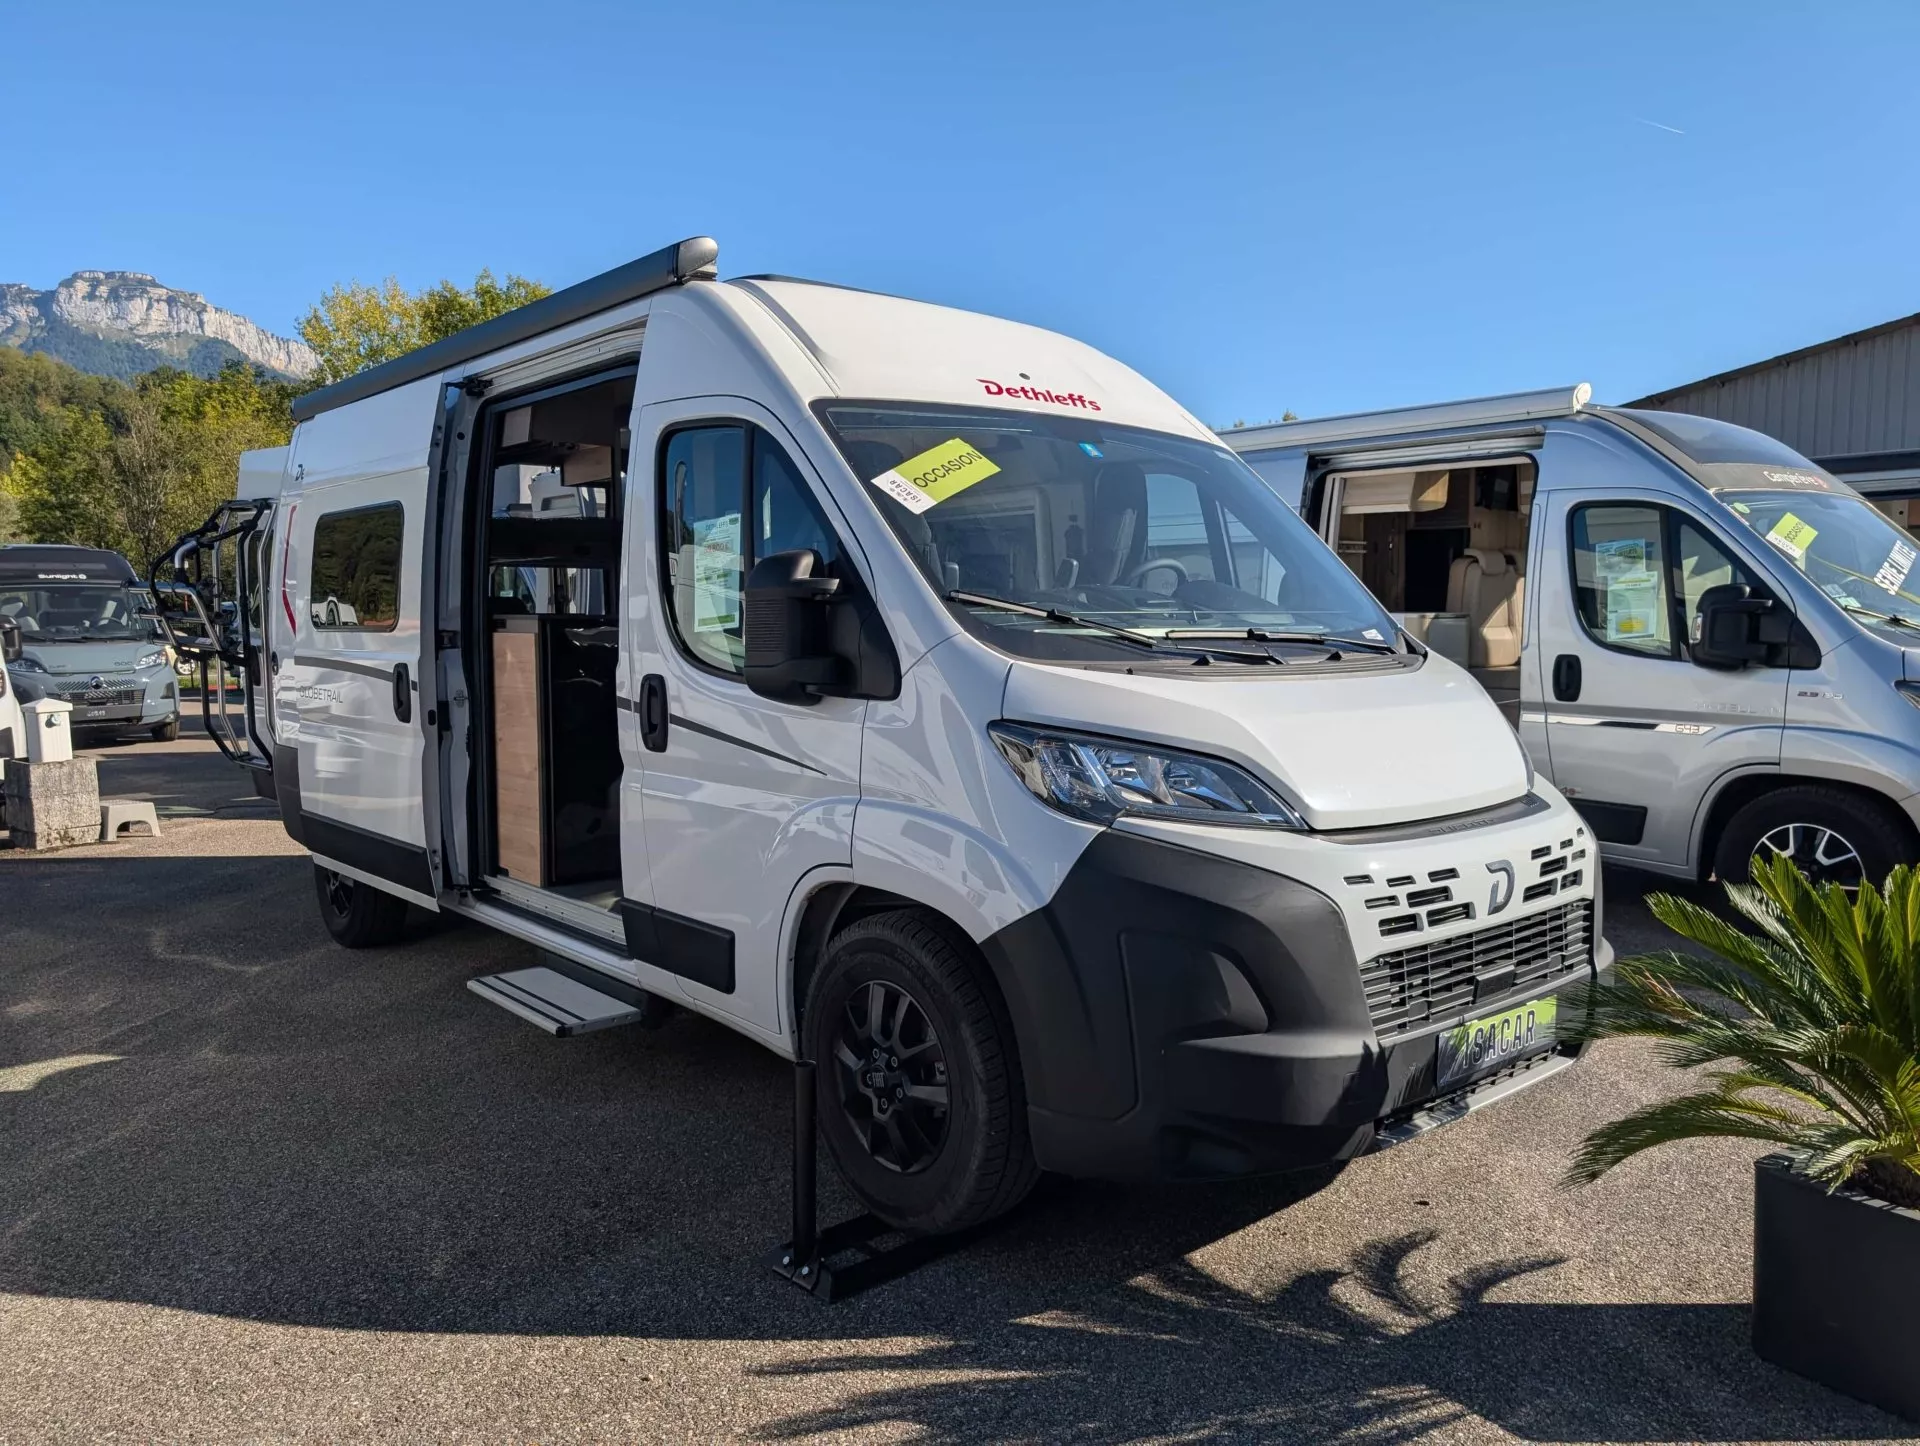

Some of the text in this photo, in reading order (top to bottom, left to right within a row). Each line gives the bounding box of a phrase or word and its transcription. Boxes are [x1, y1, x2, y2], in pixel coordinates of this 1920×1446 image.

[976, 378, 1102, 411] Dethleffs
[913, 449, 983, 488] OCCASION
[889, 480, 922, 503] ISACAR
[1462, 1008, 1537, 1069] ISACAR
